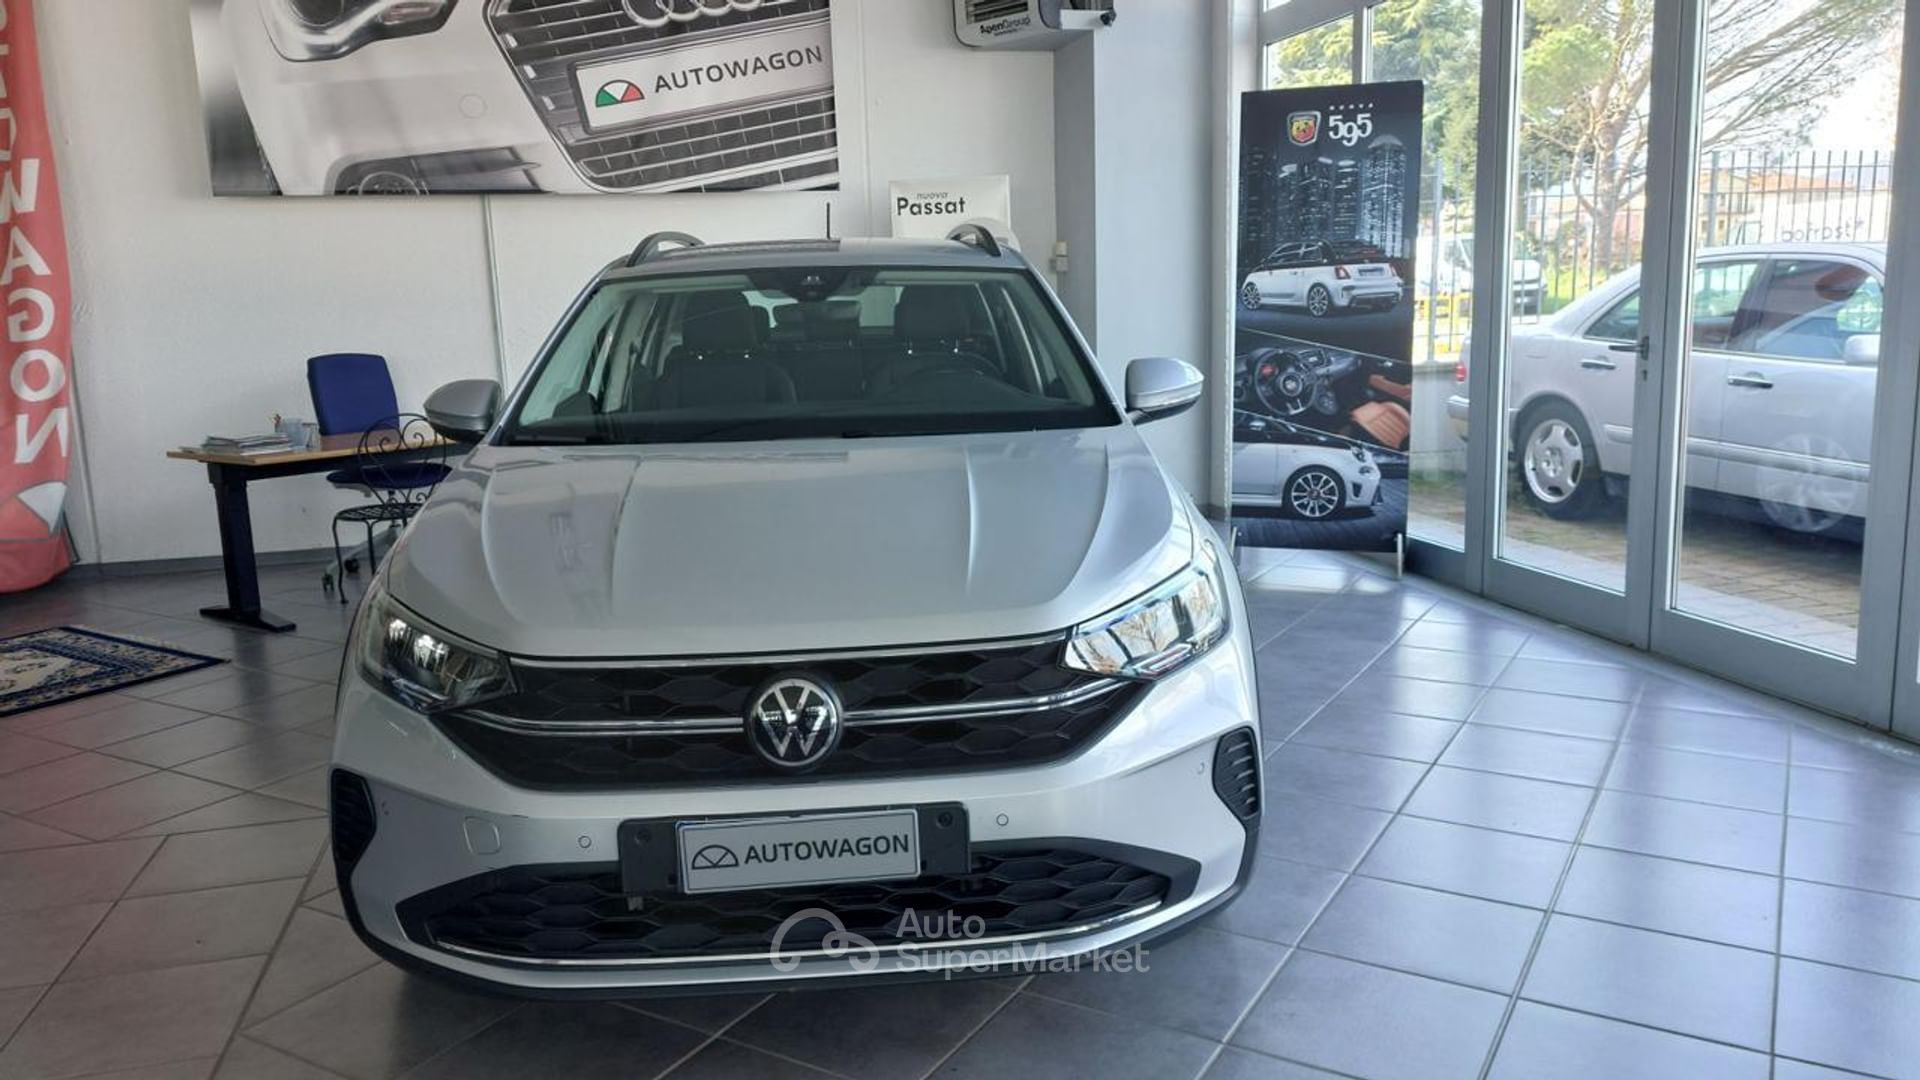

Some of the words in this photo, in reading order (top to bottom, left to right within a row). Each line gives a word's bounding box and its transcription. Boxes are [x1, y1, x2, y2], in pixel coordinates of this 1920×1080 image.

[654, 46, 823, 93] AUTOWAGON
[1328, 113, 1373, 147] 595
[897, 197, 965, 216] Passat
[744, 834, 910, 865] AUTOWAGON
